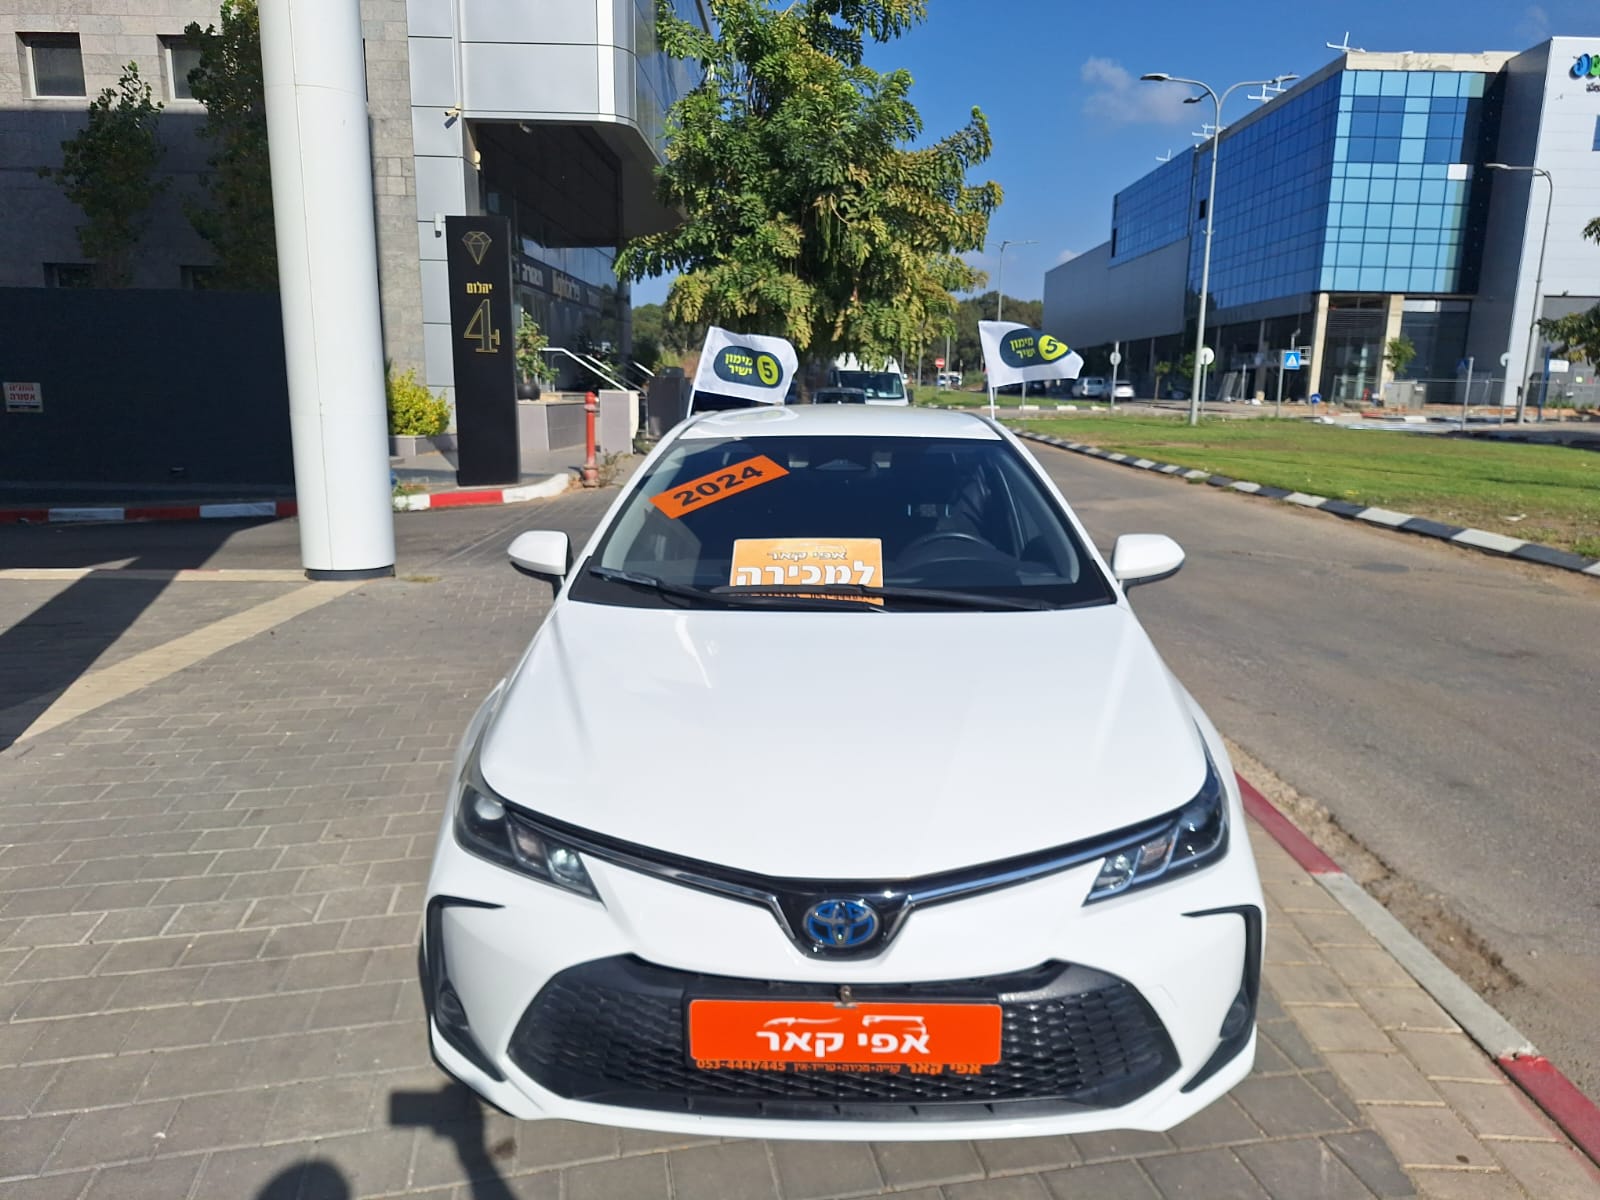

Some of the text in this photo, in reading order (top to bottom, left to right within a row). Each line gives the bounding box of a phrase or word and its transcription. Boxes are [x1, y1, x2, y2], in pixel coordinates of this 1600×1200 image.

[466, 281, 493, 294] יהלום
[464, 299, 500, 353] 4
[1010, 337, 1034, 351] מימון
[1045, 339, 1058, 354] 5
[725, 353, 754, 367] מימון
[1016, 348, 1035, 359] ישיר
[728, 364, 753, 376] ישיר
[762, 361, 773, 379] 5
[673, 466, 764, 507] 2024
[767, 551, 848, 562] אפי קאר
[735, 559, 875, 586] למכירה
[755, 1031, 931, 1058] אפי קאר
[906, 1062, 943, 1076] קאר
[949, 1062, 982, 1075] אפי
